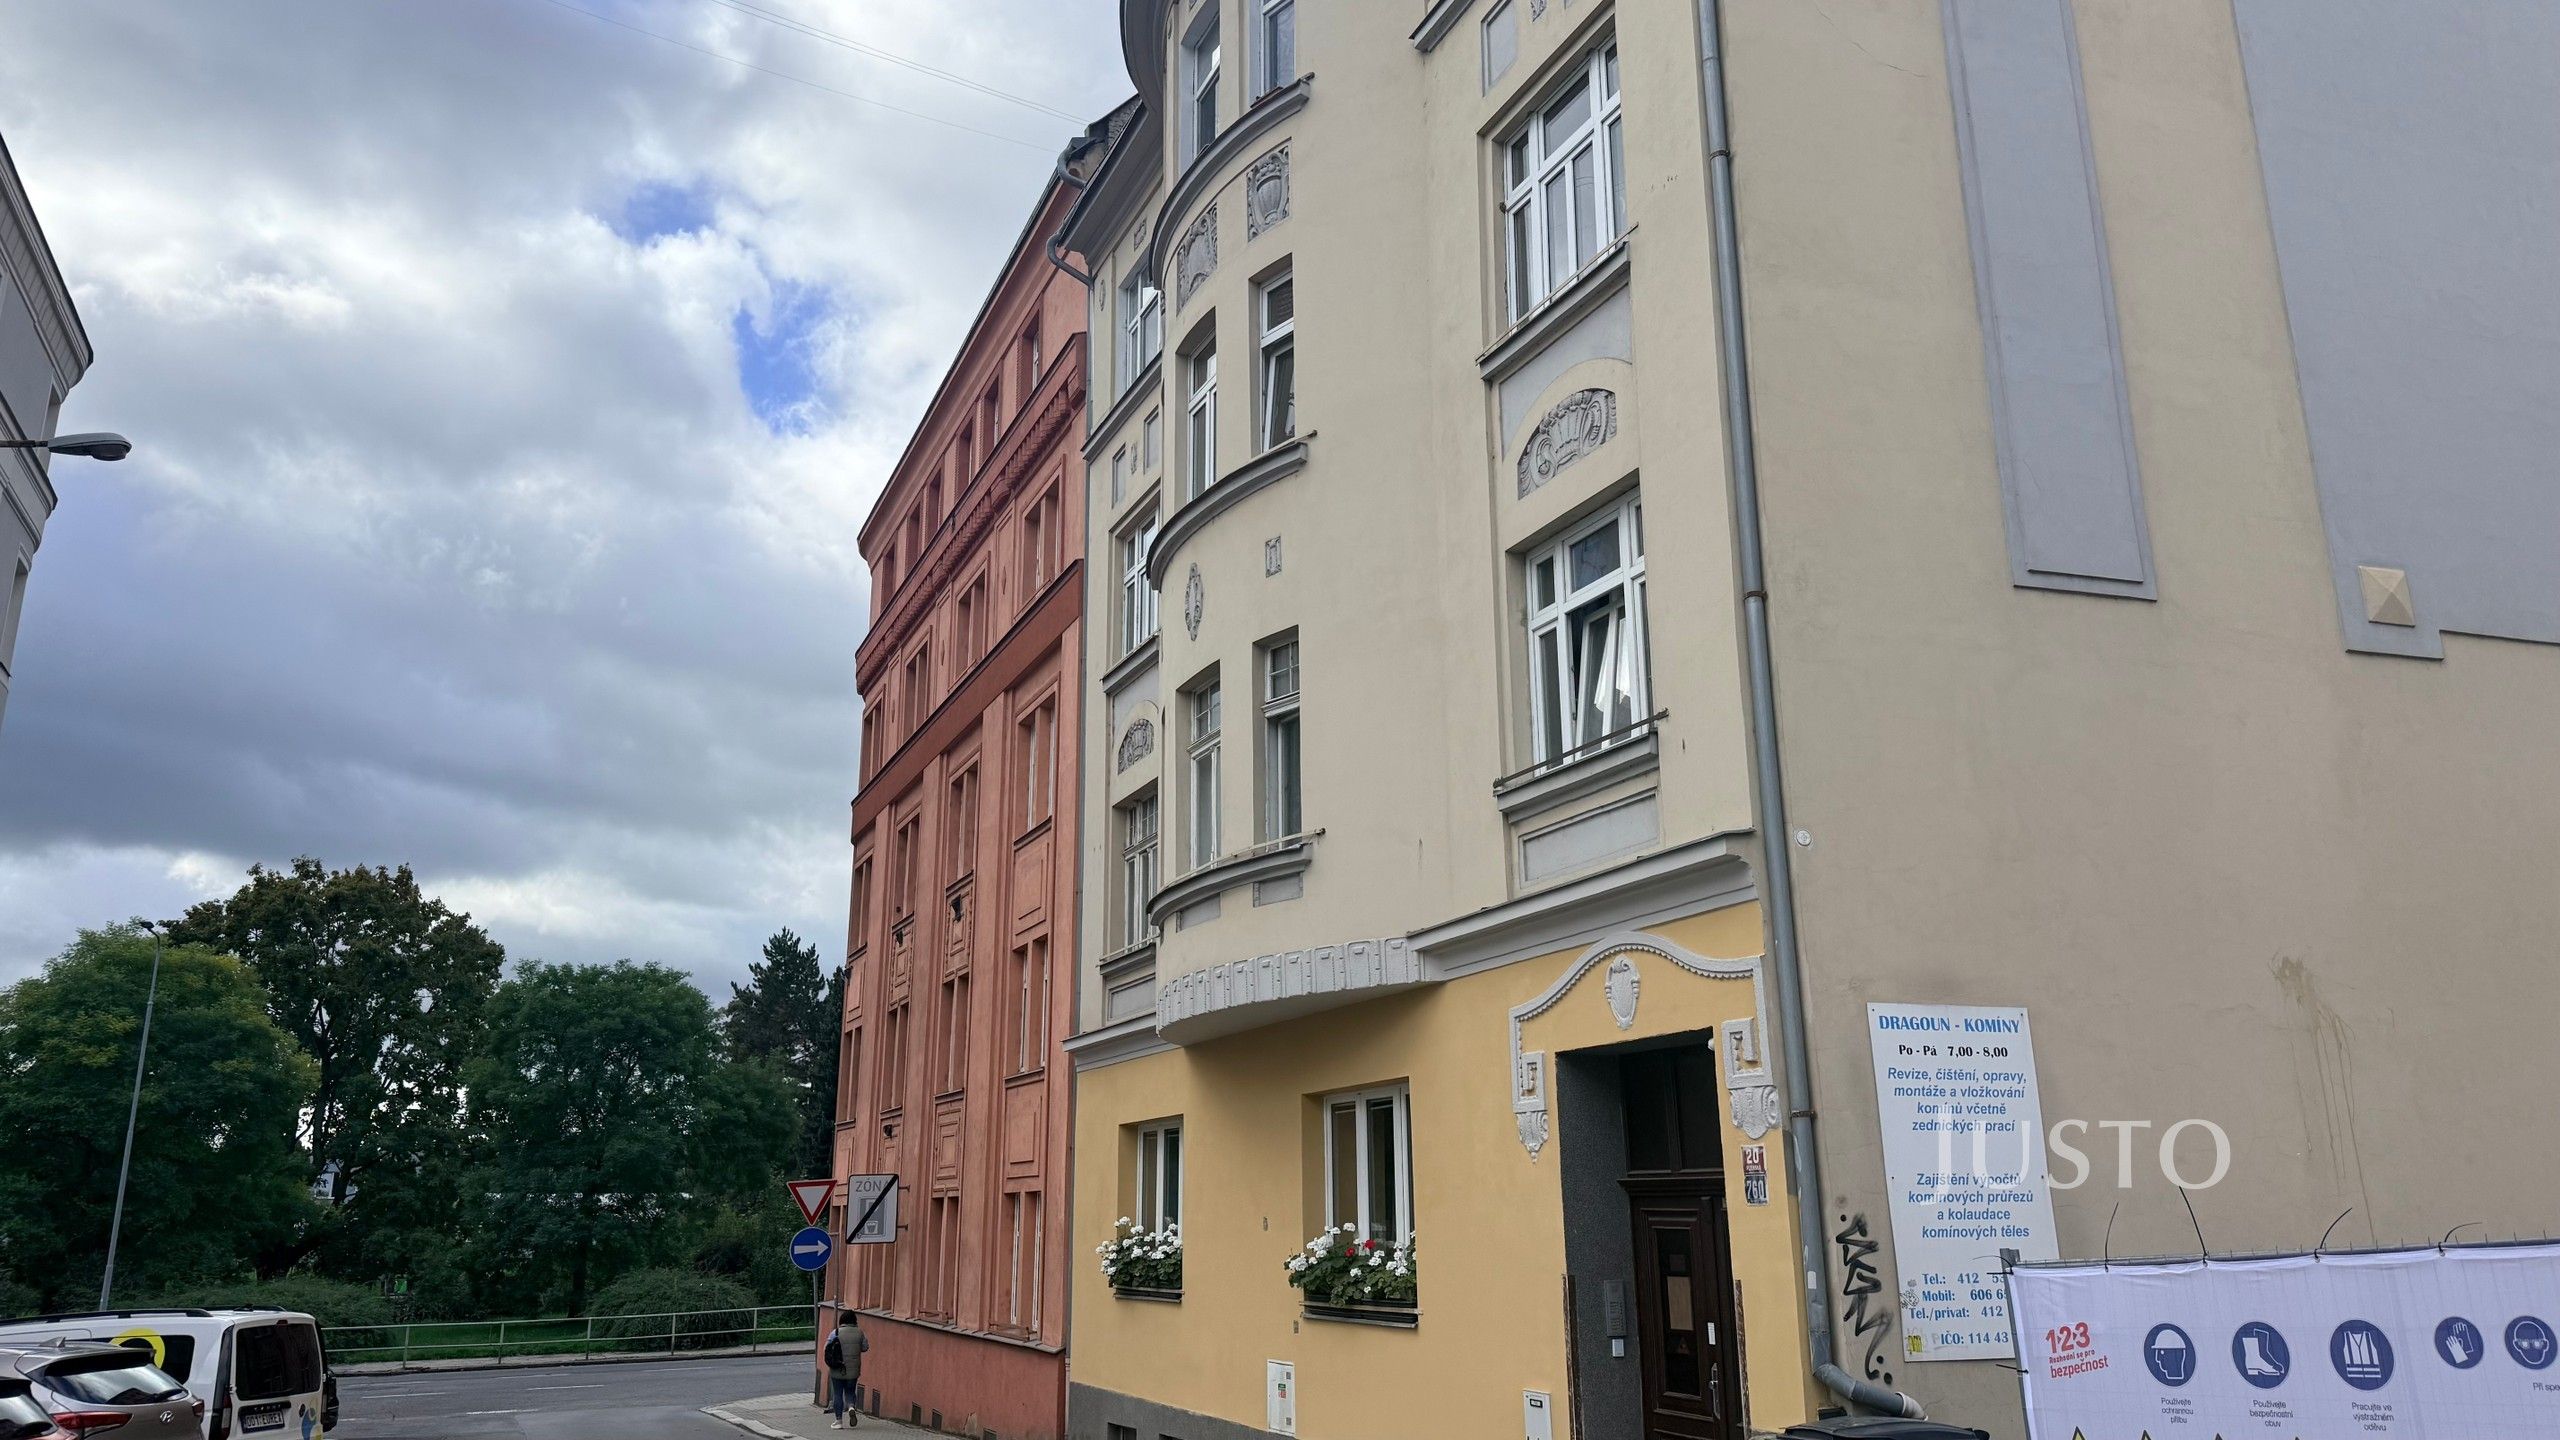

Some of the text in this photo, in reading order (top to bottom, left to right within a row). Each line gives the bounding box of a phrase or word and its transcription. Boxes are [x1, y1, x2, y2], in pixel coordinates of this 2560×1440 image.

[1878, 1015, 1951, 1032] DRAGOUN
[1964, 1017, 2020, 1033] KOMÍNY
[1898, 1044, 1913, 1056] Po
[1923, 1045, 1937, 1056] Pá
[1947, 1046, 1973, 1058] 7,00
[1983, 1046, 2008, 1059] 8,00
[1888, 1067, 2027, 1084] Revize, čištění, opravy,
[1894, 1085, 2025, 1099] montáže a vložkování
[1917, 1102, 2007, 1115] komínů včetně
[1912, 1120, 2015, 1134] zednických prací
[1745, 1148, 1760, 1164] 20
[1917, 1173, 2022, 1188] Zajištění výpočtů
[1746, 1180, 1765, 1200] 760
[1908, 1190, 2033, 1205] komínových průřezů
[1937, 1208, 2011, 1220] a kolaudace
[1922, 1225, 2030, 1240] komínových těles
[1922, 1273, 1946, 1285] Tel.:
[1957, 1272, 1980, 1284] 412
[1922, 1290, 1956, 1302] Mobil:
[1970, 1289, 1992, 1301] 606
[1909, 1305, 2003, 1321] Tel./privat: 412
[1940, 1330, 1964, 1344] IČO:
[1968, 1332, 1990, 1344] 114
[1994, 1331, 2009, 1343] 43
[2076, 1351, 2084, 1359] se
[2084, 1349, 2096, 1358] pro
[2050, 1355, 2109, 1378] bezpečnost
